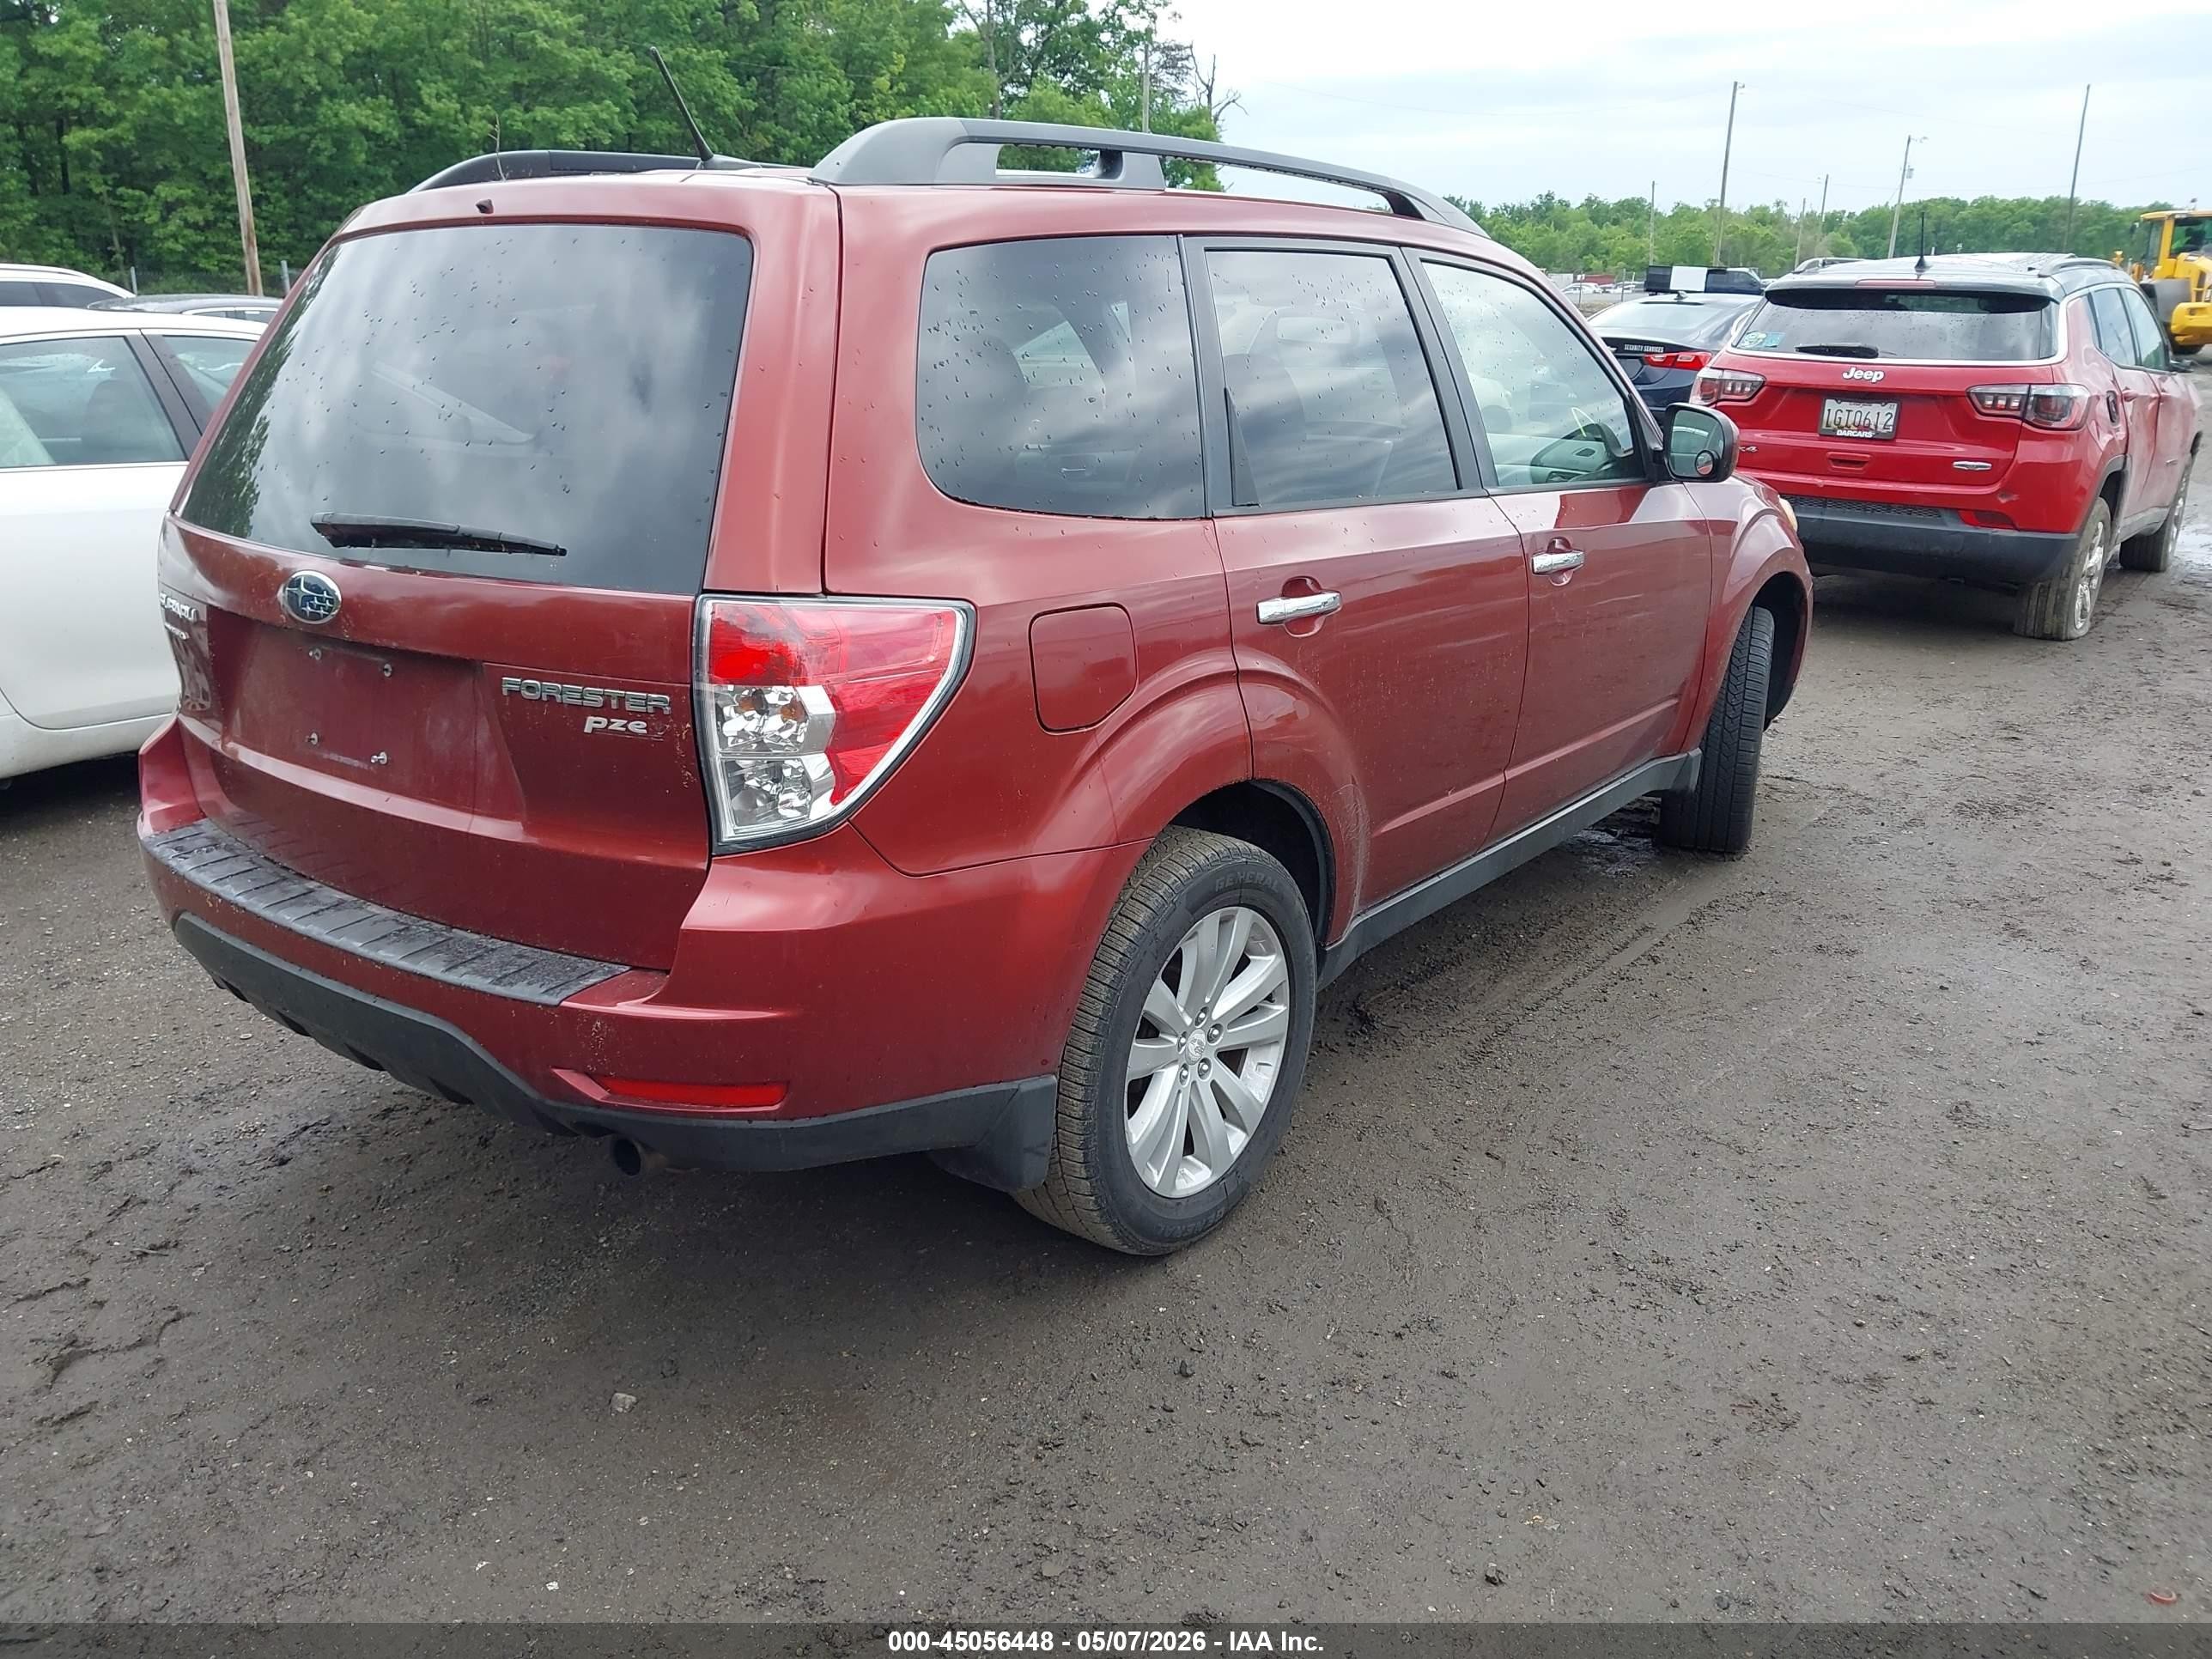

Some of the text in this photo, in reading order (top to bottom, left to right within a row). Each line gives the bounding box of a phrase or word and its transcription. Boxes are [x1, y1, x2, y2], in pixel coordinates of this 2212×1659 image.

[1842, 367, 1884, 383] Jeep
[1836, 429, 1874, 438] DARCARS
[501, 677, 671, 714] FORESTER
